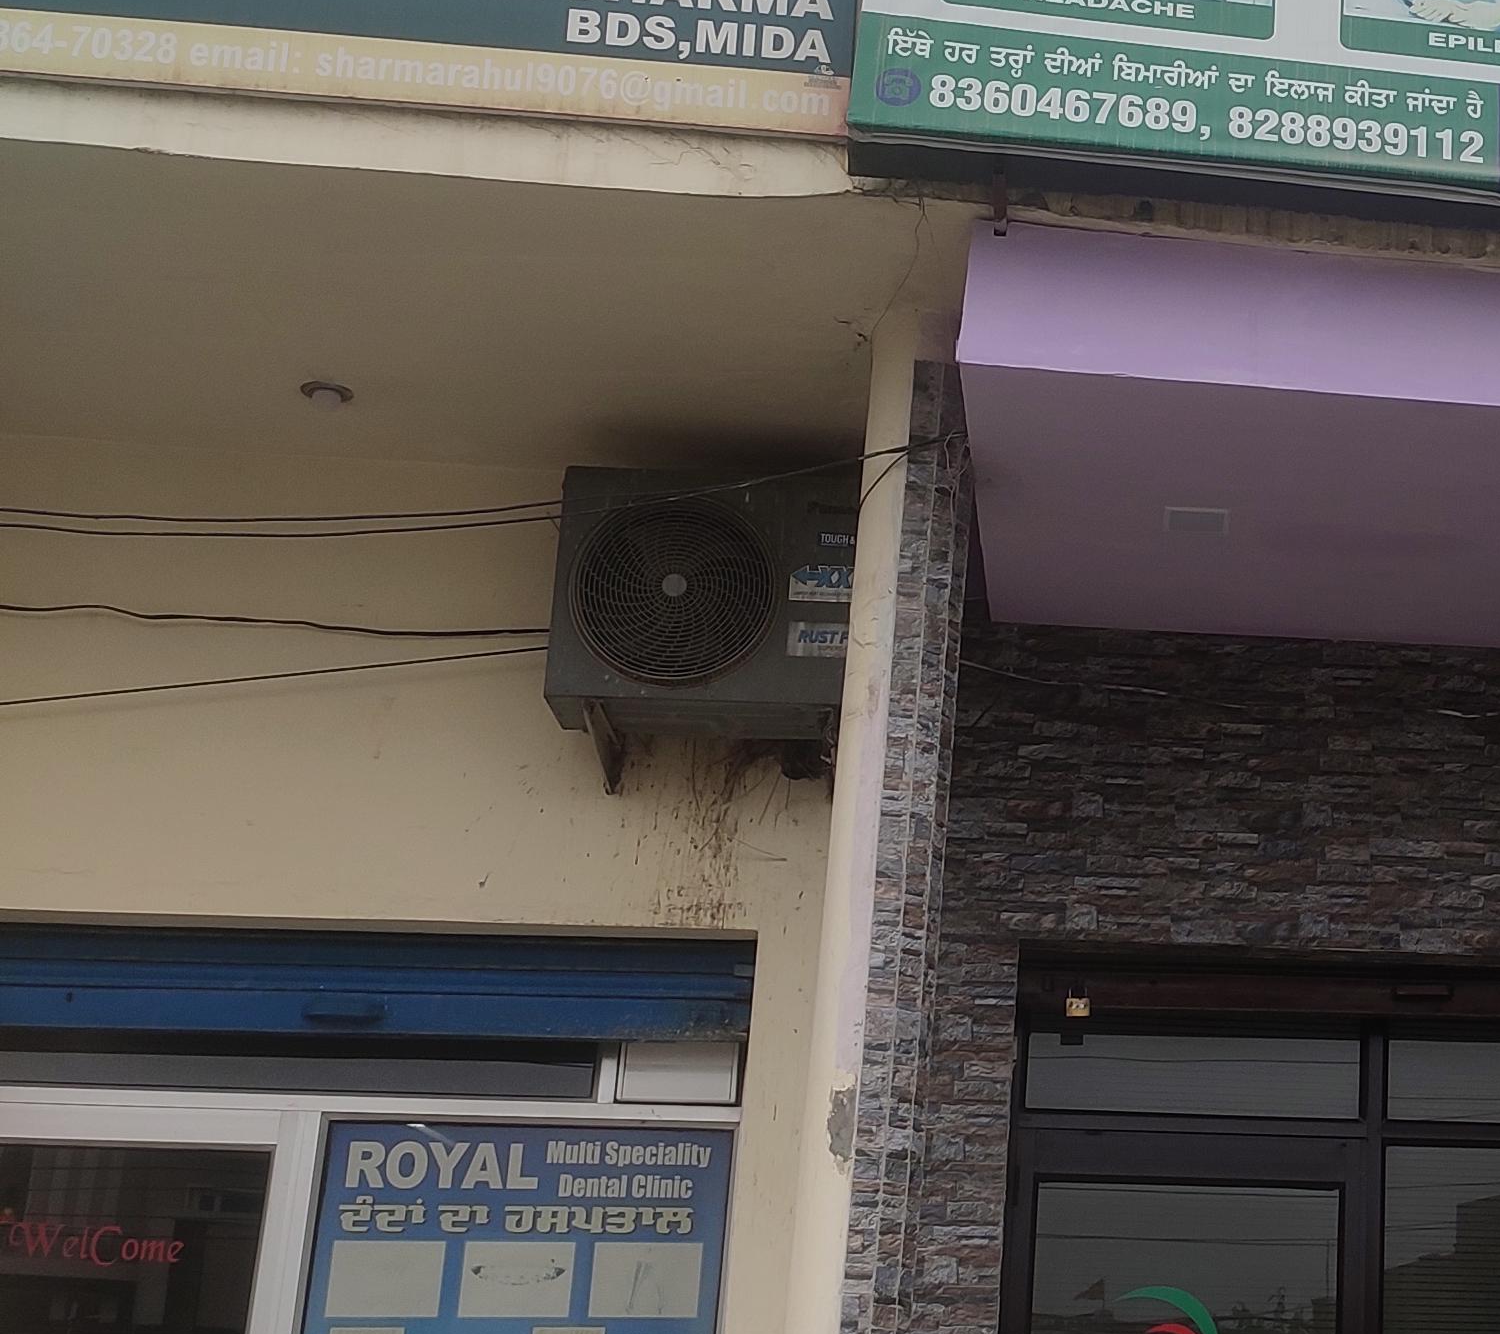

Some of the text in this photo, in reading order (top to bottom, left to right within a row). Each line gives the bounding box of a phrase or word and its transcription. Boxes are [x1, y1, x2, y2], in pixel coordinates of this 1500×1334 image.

[566, 8, 831, 64] BDS,MIDA
[190, 41, 302, 75] email:
[943, 40, 980, 65] ਹਰ
[1044, 47, 1102, 78] ਦੀਆਂ
[1228, 72, 1254, 94] ਦਾ
[1264, 69, 1336, 103] ਇਲਾਜ
[1344, 79, 1397, 109] ਕੀਤਾ
[1465, 90, 1484, 120] ਹੈ
[1228, 105, 1485, 164] 8288939112
[820, 532, 849, 545] TOUGH
[798, 629, 837, 645] RUST
[345, 1140, 712, 1191] ROYAL Multi Speciality
[558, 1173, 693, 1199] Dental Clinic
[437, 1204, 490, 1233] ਦਾ
